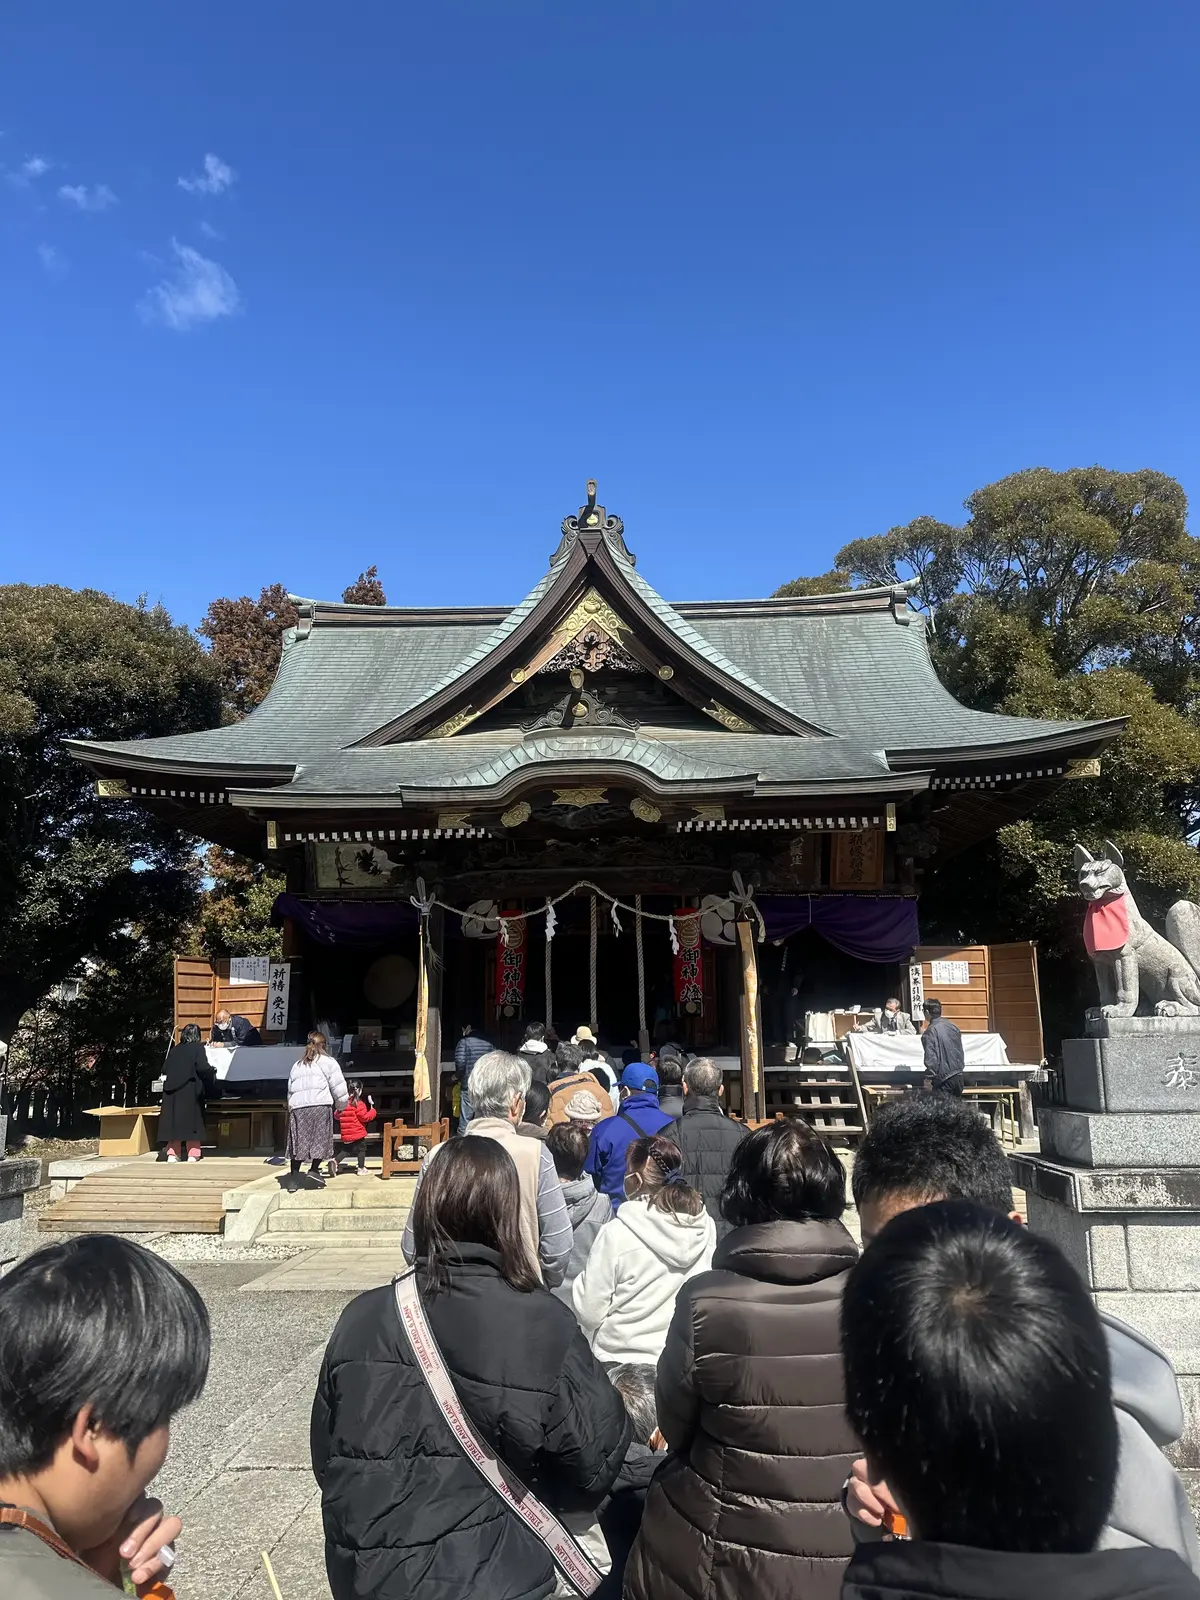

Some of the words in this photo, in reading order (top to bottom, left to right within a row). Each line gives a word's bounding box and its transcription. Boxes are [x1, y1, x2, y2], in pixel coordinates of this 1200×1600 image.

[500, 949, 524, 1006] 御神燈
[679, 948, 704, 1003] 御神燈
[403, 1305, 413, 1321] LANE
[410, 1329, 420, 1344] AND
[416, 1347, 431, 1369] STREET
[442, 1400, 454, 1419] LANE
[455, 1424, 467, 1440] AND
[464, 1440, 483, 1461] STREET
[498, 1481, 513, 1498] LANE
[514, 1498, 526, 1511] AND
[523, 1510, 542, 1527] STREET
[554, 1544, 565, 1558] LANE
[565, 1560, 577, 1573] AND
[573, 1571, 589, 1589] STREET
